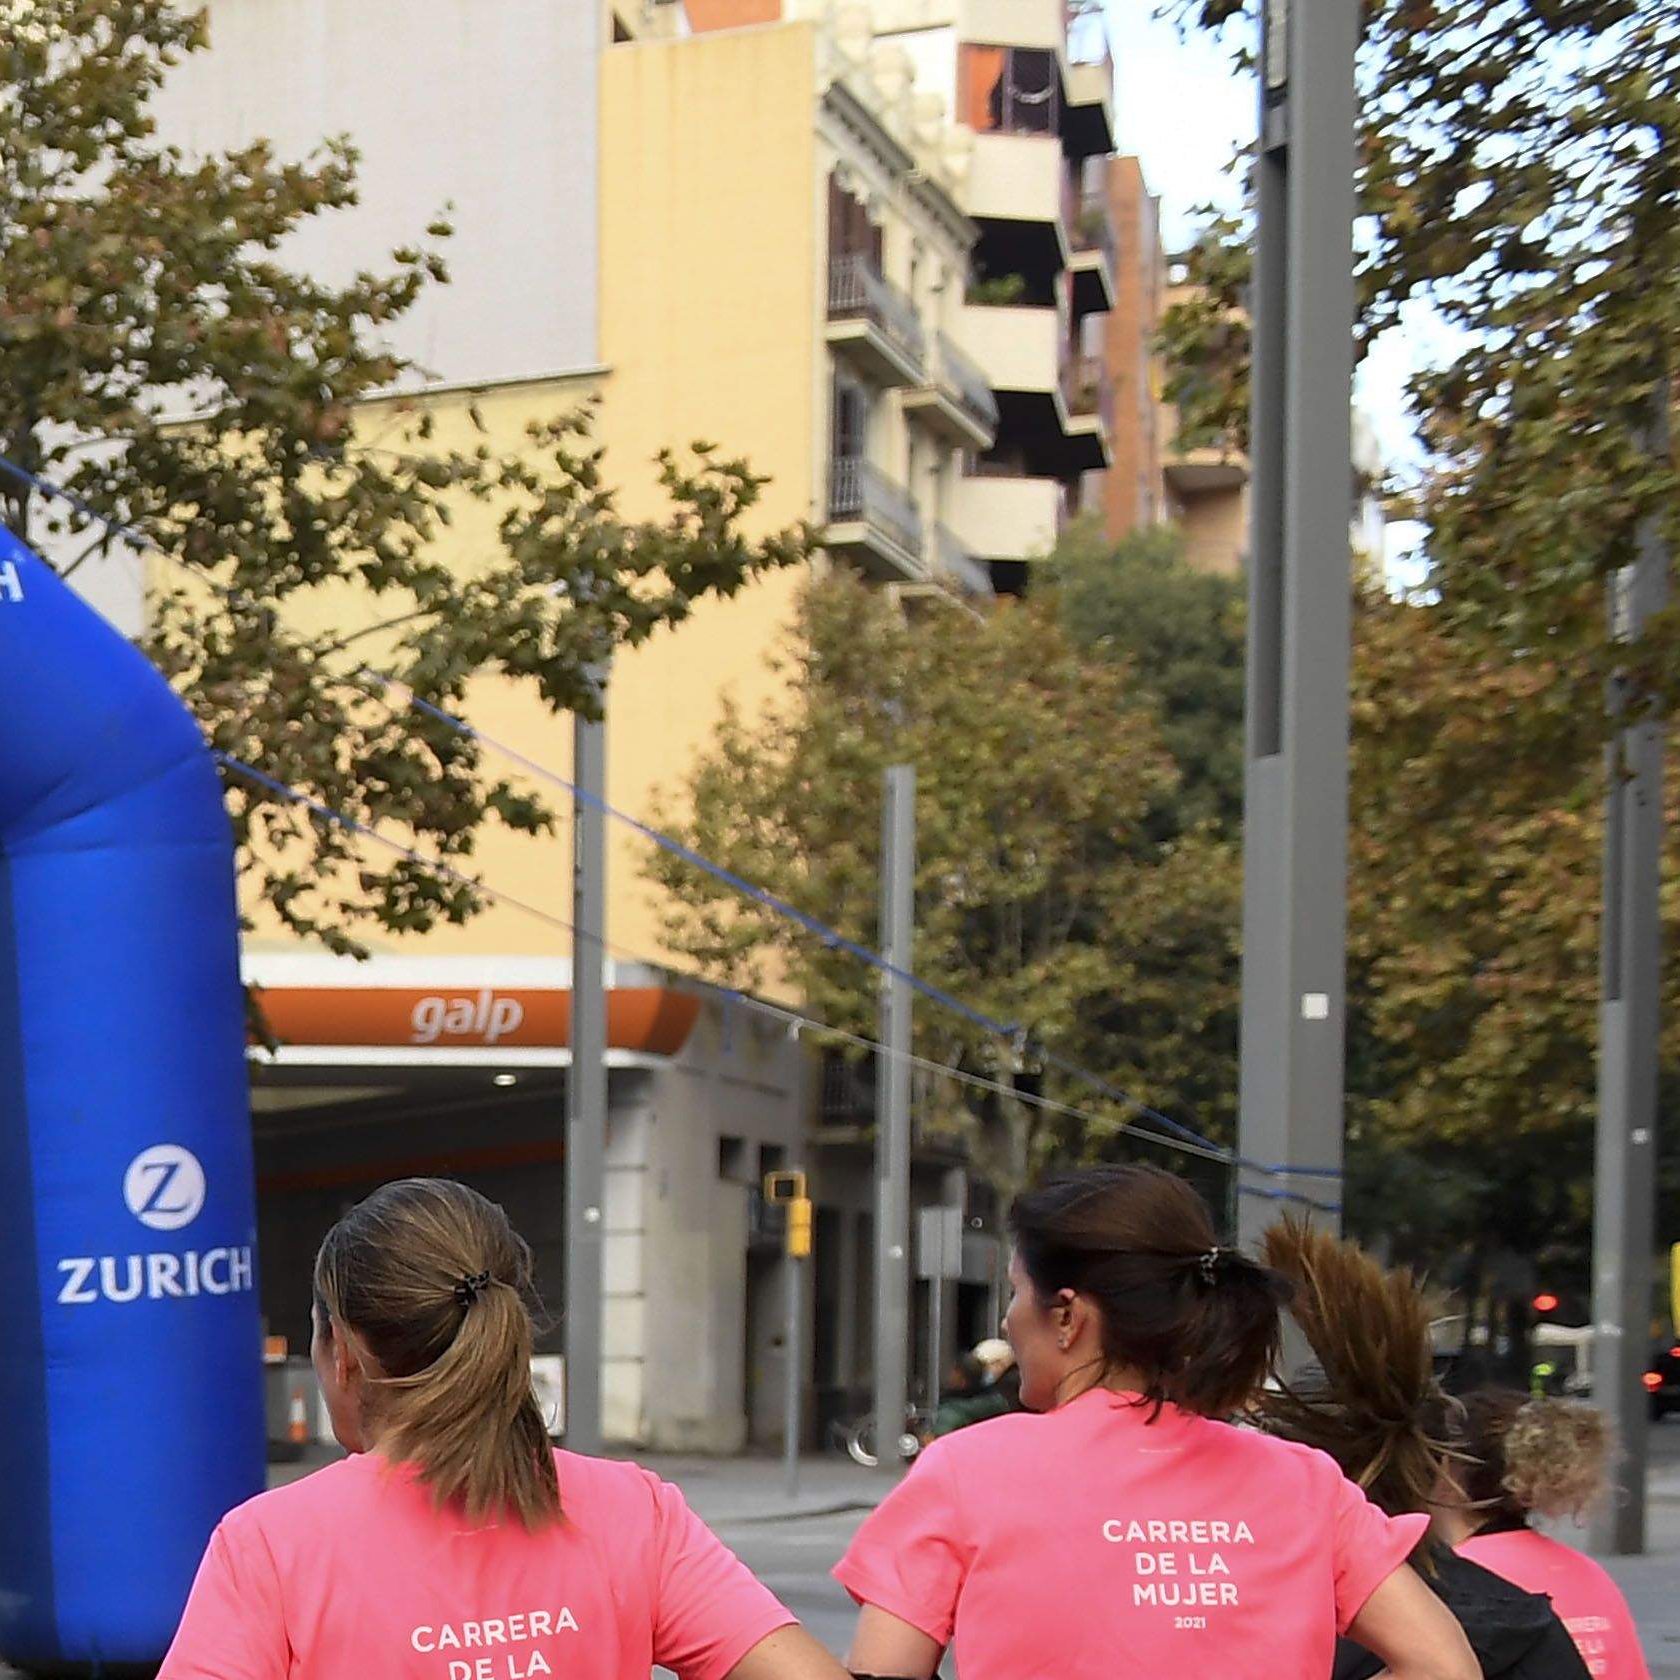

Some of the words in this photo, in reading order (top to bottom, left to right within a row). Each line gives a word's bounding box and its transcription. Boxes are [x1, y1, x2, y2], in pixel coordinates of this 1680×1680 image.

[410, 988, 524, 1044] galp
[56, 1246, 253, 1304] ZURICH
[1102, 1519, 1255, 1544] CARRERA
[1135, 1552, 1177, 1575] DE
[1188, 1552, 1230, 1575] LA
[1132, 1583, 1239, 1606] MUJER
[410, 1606, 579, 1652] CARRERA
[1174, 1616, 1207, 1628] 2021
[507, 1650, 551, 1680] LA
